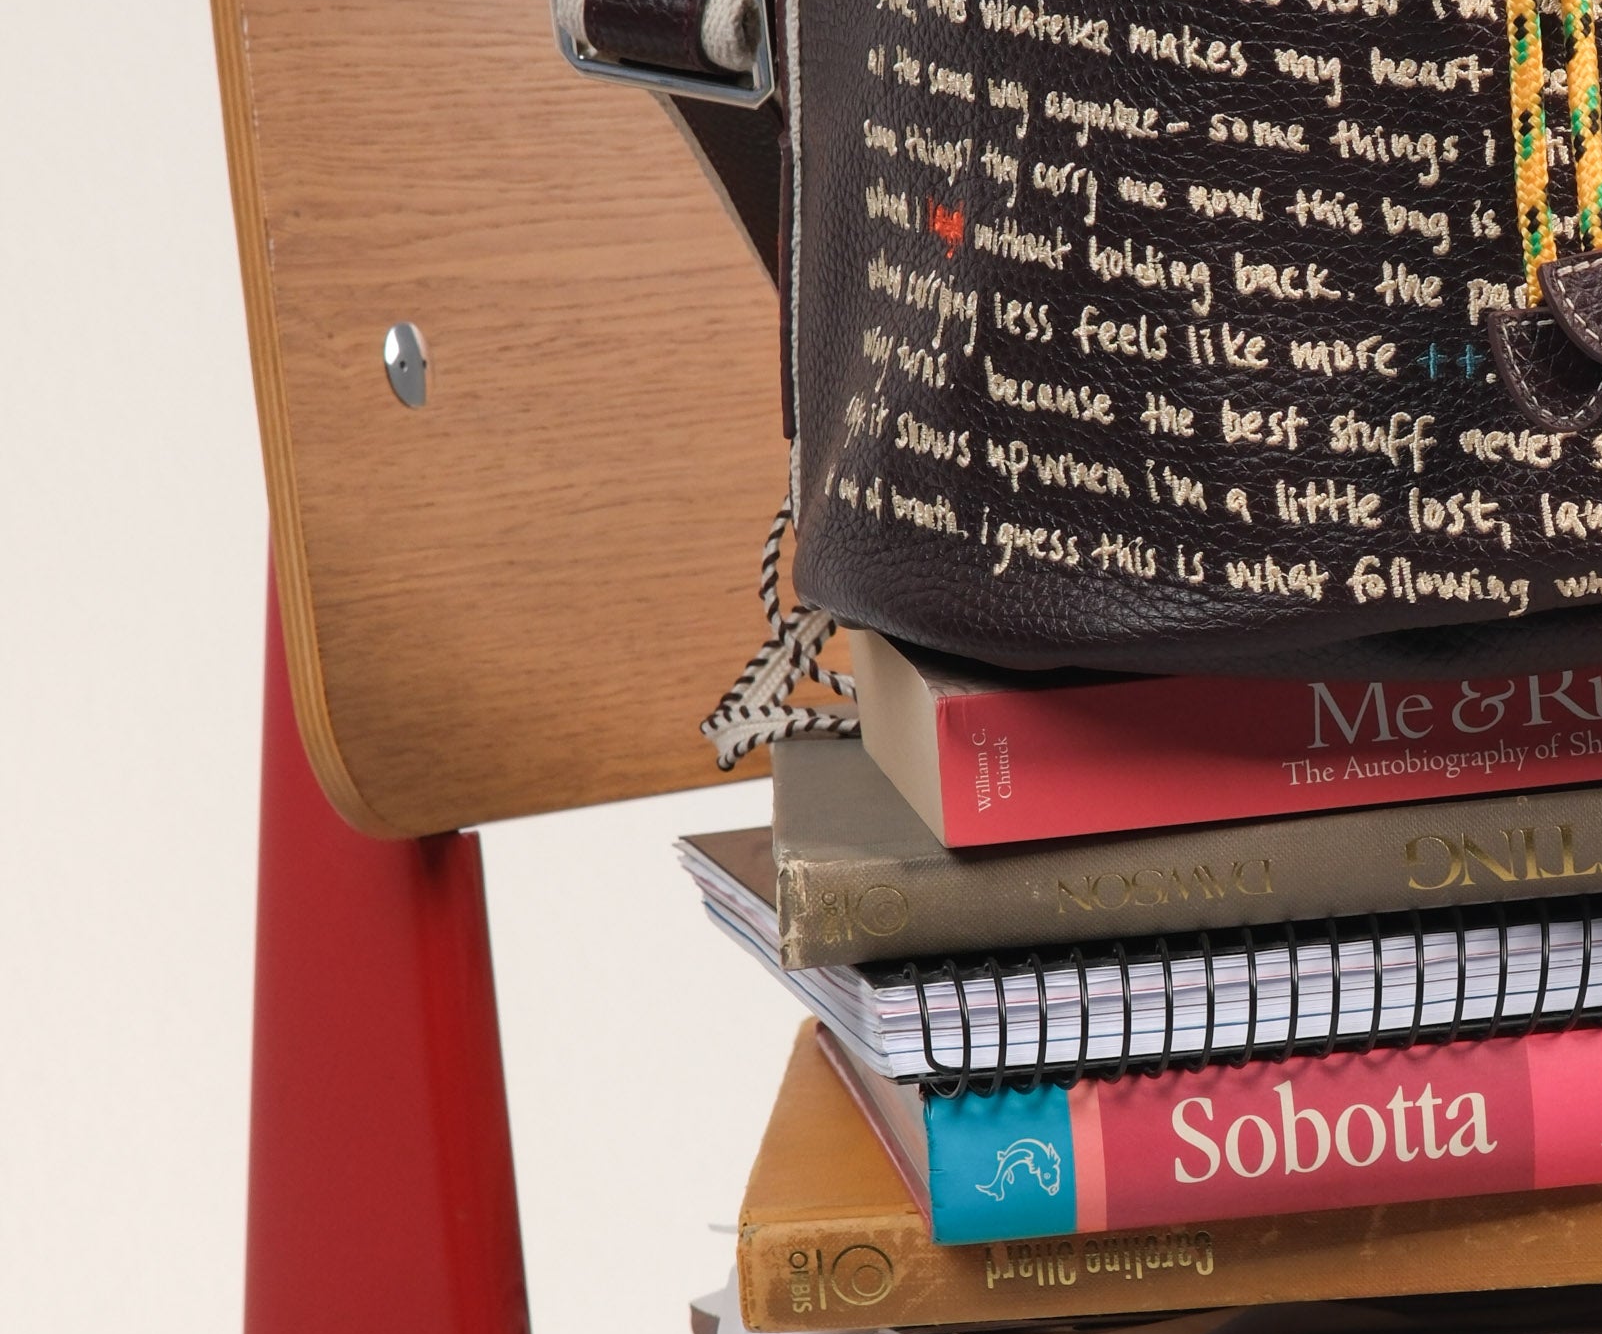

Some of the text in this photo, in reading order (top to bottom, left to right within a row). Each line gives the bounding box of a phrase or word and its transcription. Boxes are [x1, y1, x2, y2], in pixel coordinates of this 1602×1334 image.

[1128, 23, 1248, 77] makes
[1274, 48, 1342, 108] my
[1371, 46, 1494, 93] heart
[893, 45, 921, 86] the
[988, 78, 1029, 140] way
[1209, 114, 1309, 154] some
[1330, 120, 1459, 187] things
[981, 141, 1019, 209] they
[1033, 162, 1098, 227] carry
[1118, 176, 1167, 209] me
[1286, 189, 1362, 235] this
[1382, 197, 1449, 256] bag
[1470, 199, 1502, 239] is
[975, 217, 1072, 270] without
[1374, 260, 1442, 307] the
[993, 292, 1052, 343] less
[1072, 305, 1168, 360] feels
[1187, 322, 1269, 367] like
[1291, 335, 1397, 377] more
[984, 356, 1114, 425] because
[1141, 391, 1194, 436] the
[1222, 399, 1308, 451] best
[1329, 409, 1437, 473] stuff
[1459, 428, 1563, 467] never
[895, 411, 971, 467] shows
[986, 439, 1029, 493] up
[1226, 488, 1252, 524] a
[1276, 479, 1382, 528] little
[993, 522, 1080, 576] guess
[1091, 533, 1156, 579] this
[1176, 545, 1204, 583] is
[1226, 554, 1329, 602] what
[1347, 555, 1529, 617] following
[1307, 681, 1435, 749] Me
[1451, 680, 1515, 733] &
[972, 728, 992, 813] William C.
[995, 736, 1012, 799] Chittick
[1282, 760, 1336, 787] The
[1343, 741, 1529, 780] Autobiography
[1535, 733, 1563, 758] of
[1058, 859, 1273, 913] DAWSON
[1172, 1080, 1498, 1184] Sobotta
